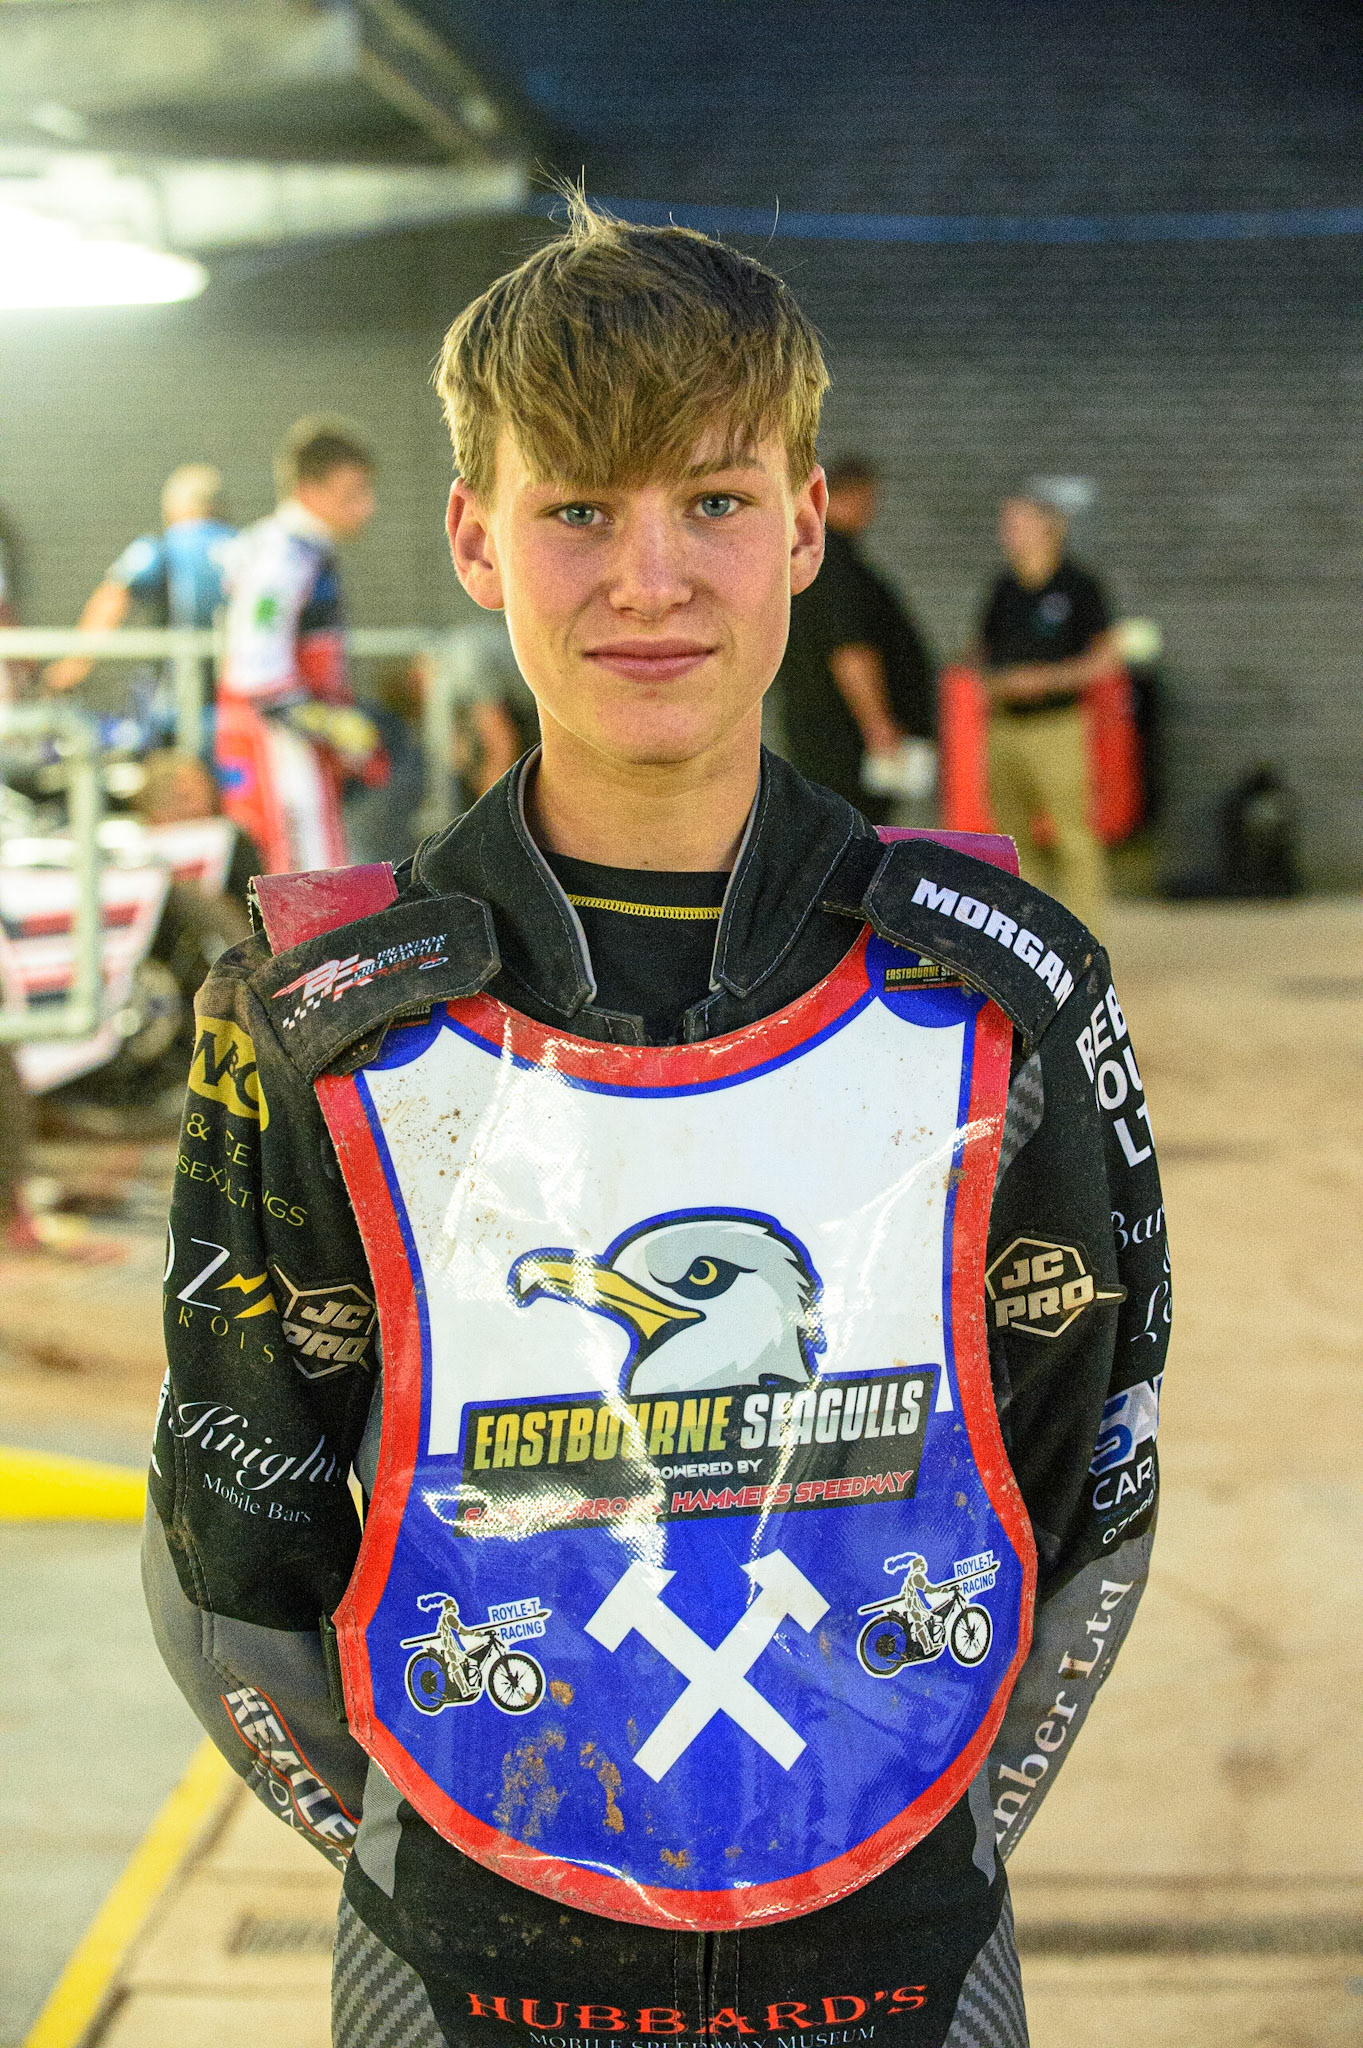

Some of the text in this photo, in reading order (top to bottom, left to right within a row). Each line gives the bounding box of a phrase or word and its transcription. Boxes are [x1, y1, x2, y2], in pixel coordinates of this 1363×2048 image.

[911, 877, 1075, 1011] MORGAN
[1001, 1249, 1065, 1290] JC
[300, 1300, 372, 1330] JC
[994, 1274, 1095, 1328] PRO
[473, 1379, 925, 1470] EASTBOURNE SEAGULLS
[737, 1458, 763, 1474] BY
[203, 1472, 312, 1524] Mobile Bars
[670, 1483, 792, 1513] HAMMERS
[794, 1469, 914, 1503] SPEEDWAY
[957, 1553, 993, 1577] ROYLE-T
[962, 1573, 994, 1595] RACING
[491, 1600, 538, 1622] ROYLE-T
[500, 1620, 543, 1641] RACING
[1057, 1579, 1134, 1680] Ltd
[466, 1985, 928, 2035] HUBBARD'S
[778, 2025, 875, 2048] MUSEUM
